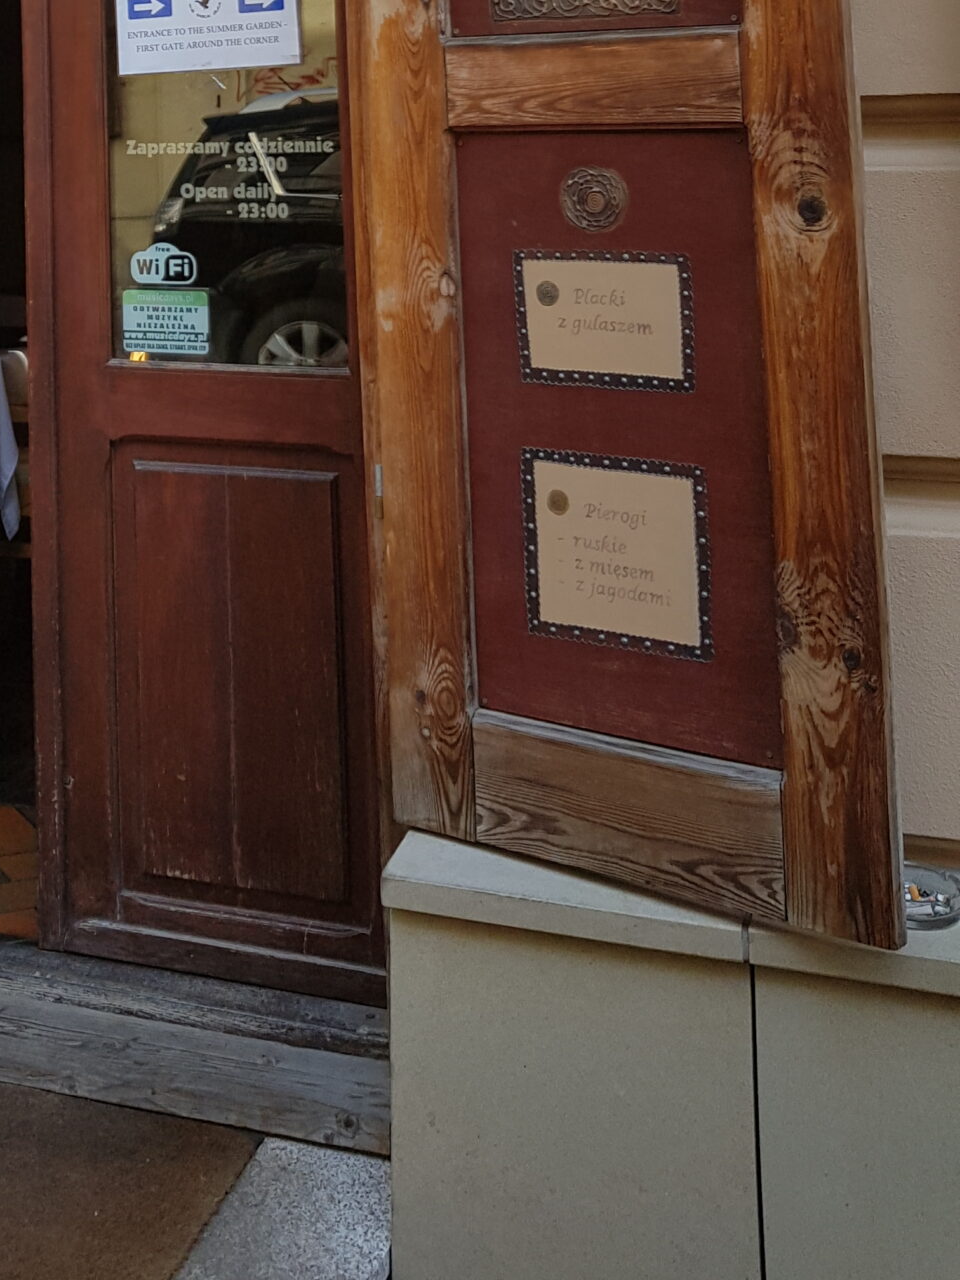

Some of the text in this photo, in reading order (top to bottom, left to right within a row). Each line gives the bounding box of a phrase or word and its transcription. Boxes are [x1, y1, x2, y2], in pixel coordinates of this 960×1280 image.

[127, 28, 173, 39] ENTRANCE
[173, 28, 186, 36] TO
[187, 26, 205, 35] THE
[206, 23, 244, 34] SUMMER
[245, 21, 282, 32] GARDEN
[136, 35, 280, 53] FIRST GATE AROUND THE CORNER
[126, 137, 334, 158] Zapraszamy codziennie
[180, 182, 277, 202] Open daily
[238, 202, 289, 219] 23:00
[573, 287, 627, 308] Placki
[132, 306, 199, 314] ODTWARZAMY
[146, 314, 184, 322] MUZYKĘ
[557, 314, 654, 336] z gulaszem
[583, 502, 648, 530] Pierogi
[572, 535, 628, 554] ruskie
[575, 558, 584, 571] z
[589, 558, 655, 581] mięsem
[575, 579, 584, 592] z
[588, 577, 672, 607] jagodami
